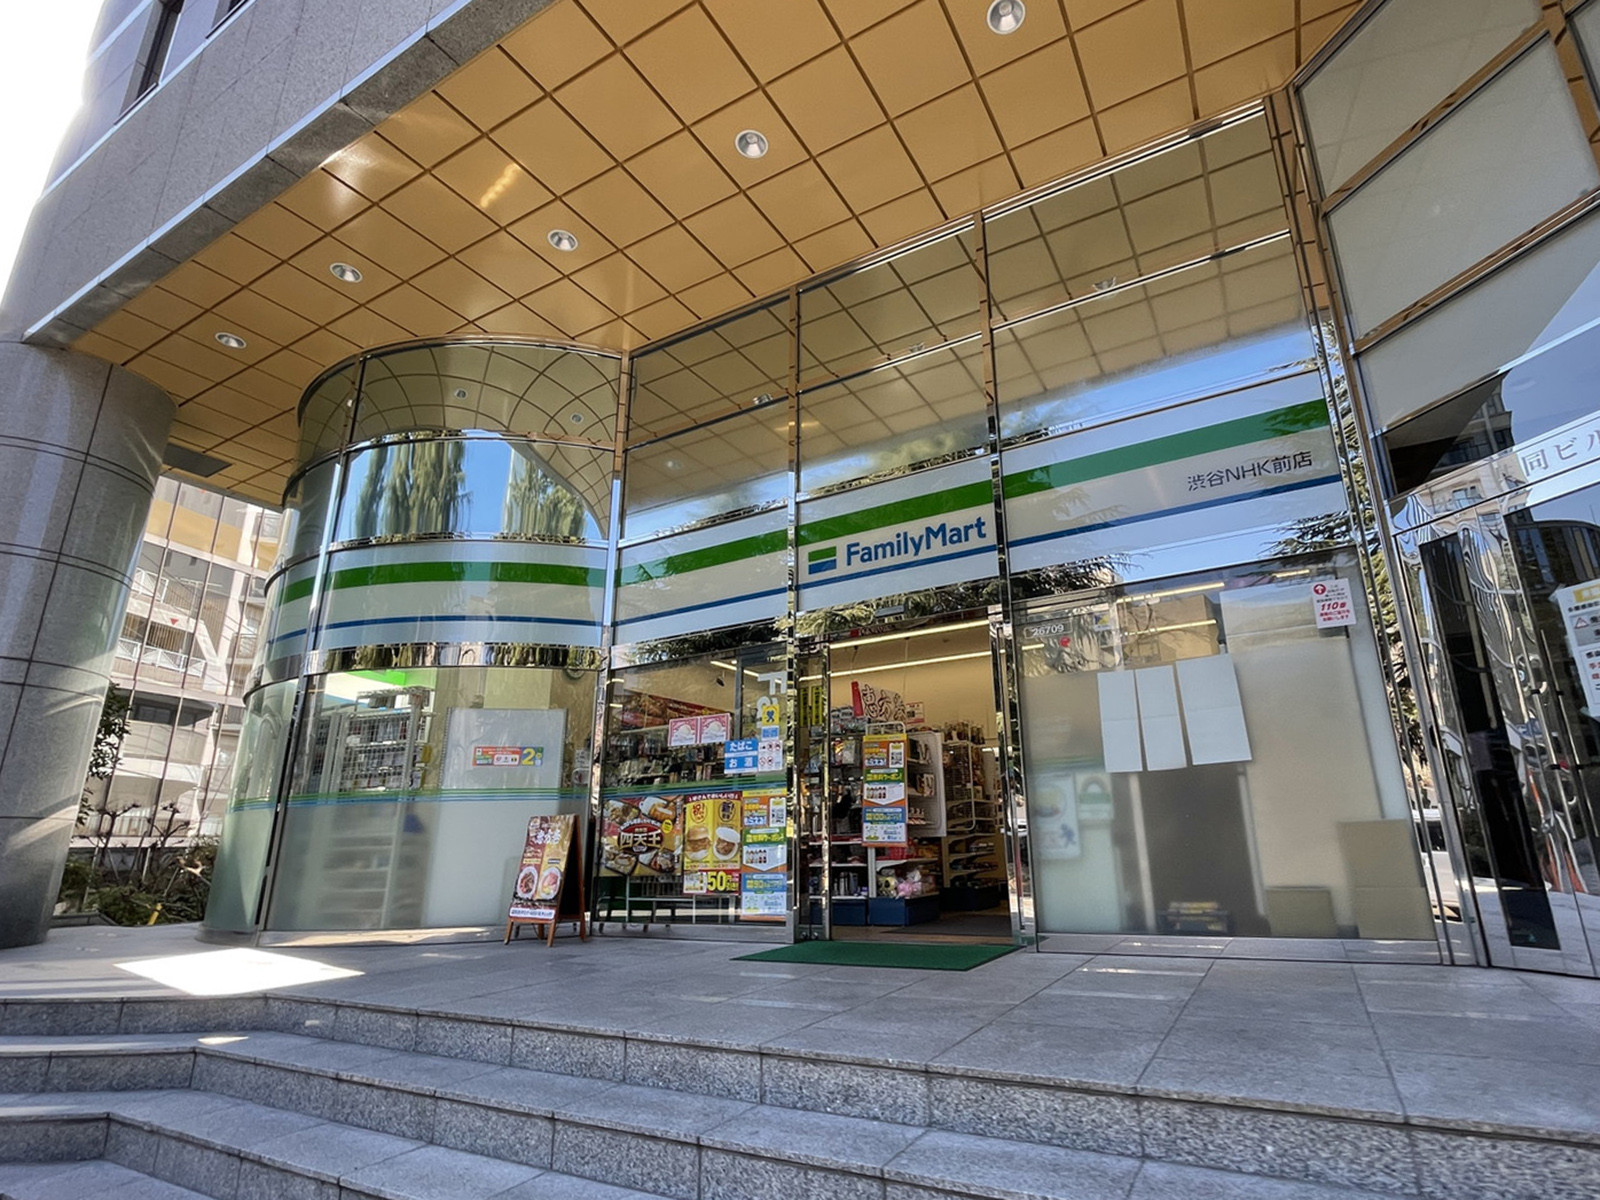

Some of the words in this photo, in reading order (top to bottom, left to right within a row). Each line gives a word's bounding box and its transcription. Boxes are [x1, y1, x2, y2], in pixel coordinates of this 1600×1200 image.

[1187, 450, 1313, 492] 渋谷NHK前店
[845, 516, 987, 567] FamilyMart
[1032, 624, 1065, 637] 26709
[729, 740, 754, 752] たばこ
[619, 828, 662, 850] 四天王
